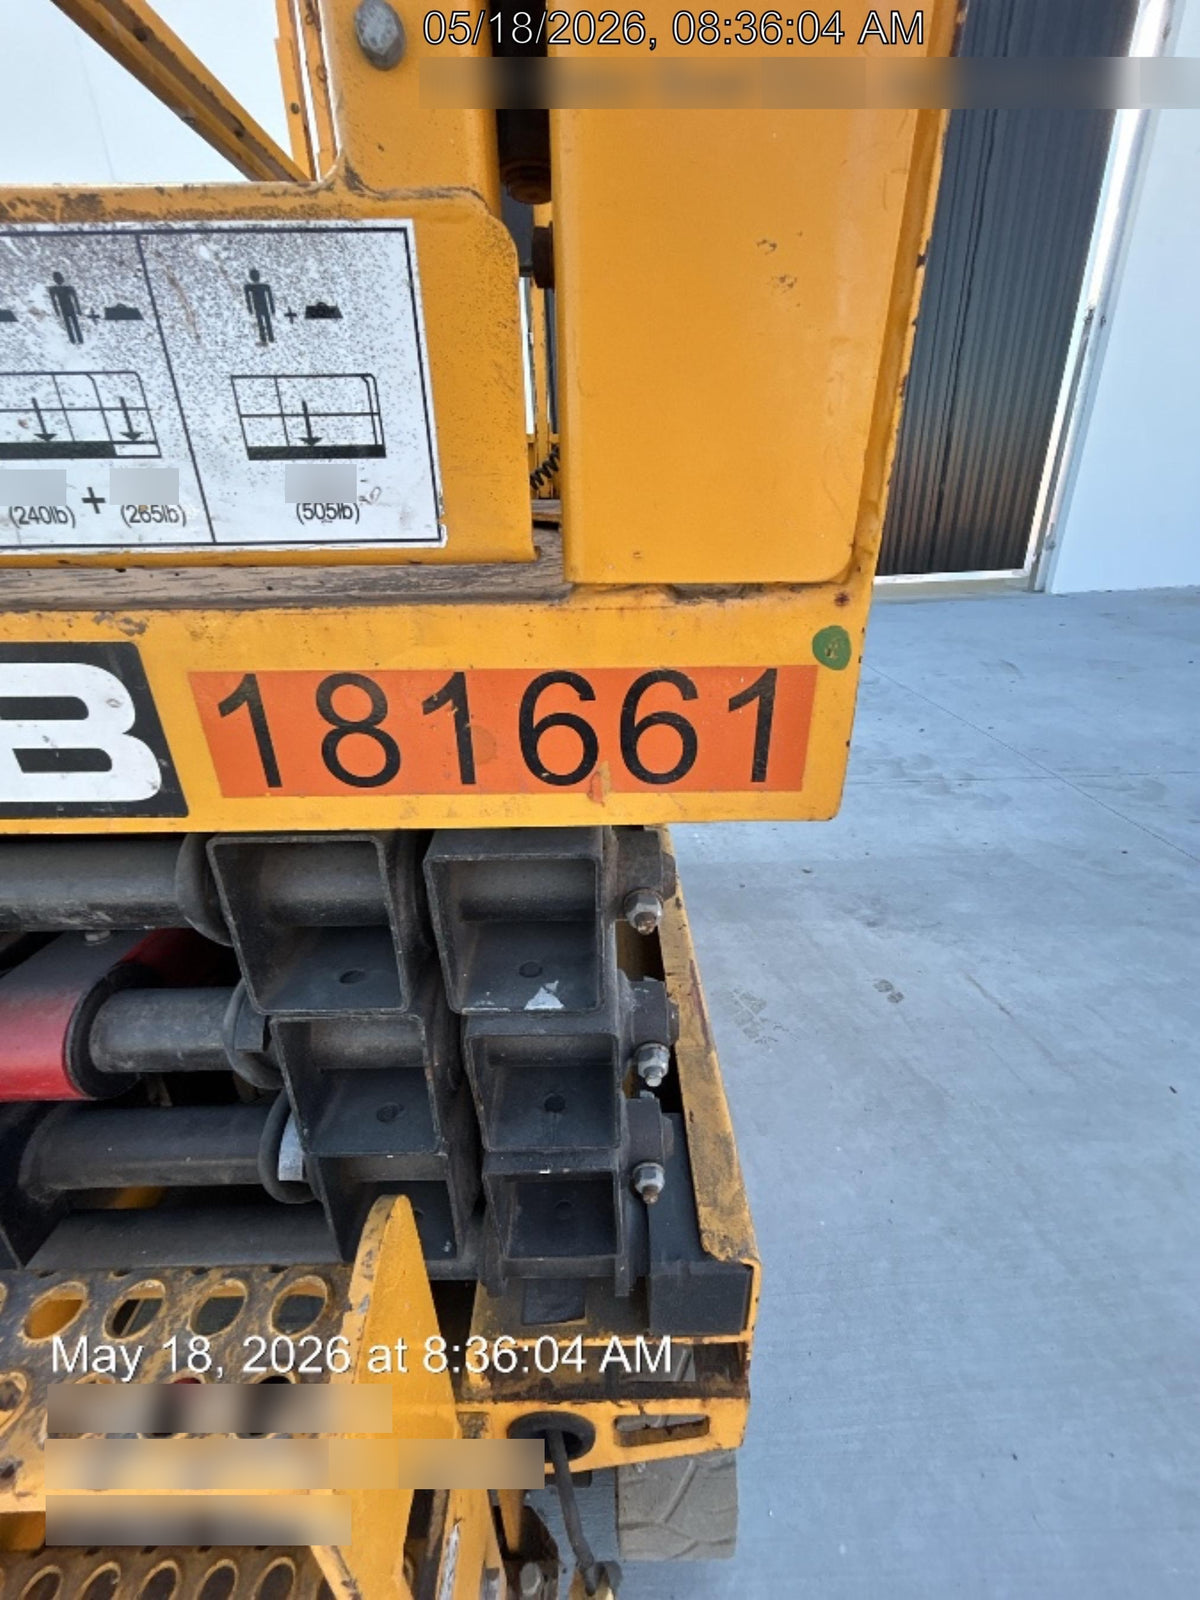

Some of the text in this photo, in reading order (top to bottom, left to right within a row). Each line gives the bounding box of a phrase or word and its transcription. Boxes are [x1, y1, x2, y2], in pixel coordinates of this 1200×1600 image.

[9, 505, 76, 529] (240lb)
[297, 502, 360, 525] (505lb)
[217, 667, 779, 788] 181661
